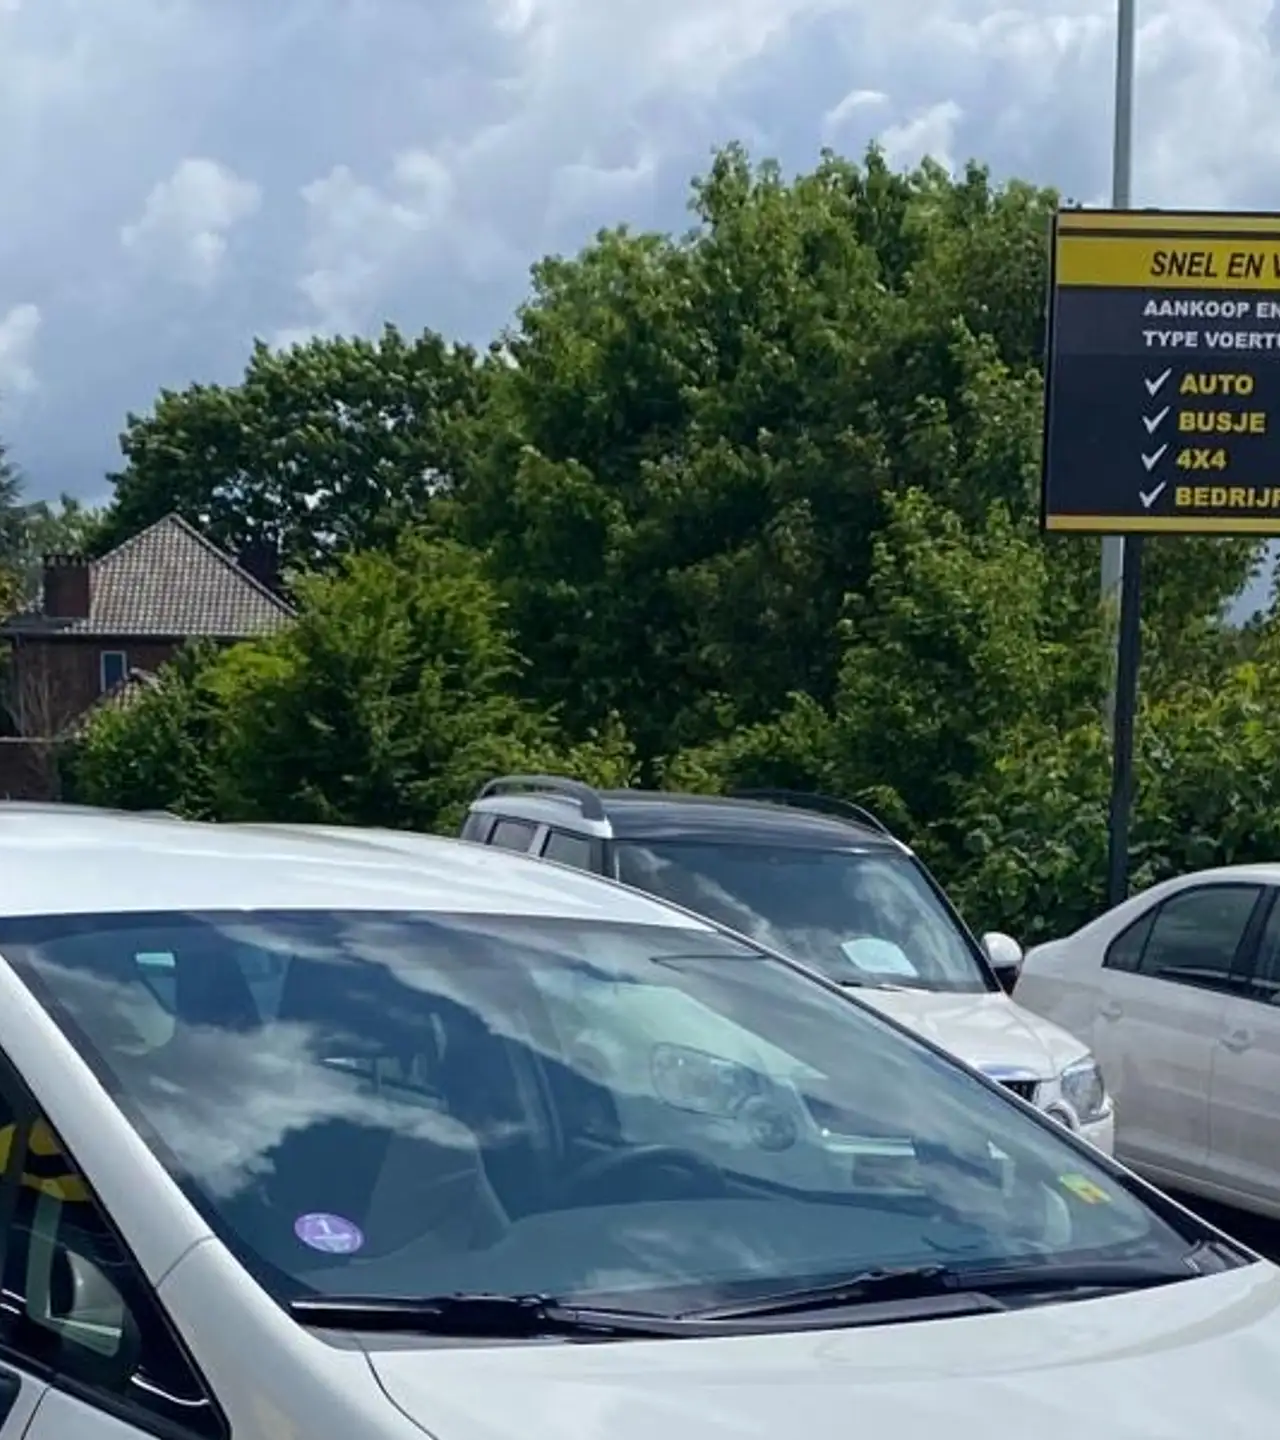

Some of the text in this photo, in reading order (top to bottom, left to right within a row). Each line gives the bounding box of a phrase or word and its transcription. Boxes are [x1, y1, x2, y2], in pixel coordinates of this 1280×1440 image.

[1150, 250, 1217, 277] SNEL
[1226, 252, 1265, 278] EN
[1143, 300, 1249, 318] AANKOOP
[1143, 331, 1198, 348] TYPE
[1179, 374, 1254, 395] AUTO
[1178, 412, 1266, 433] BUSJE
[1176, 449, 1227, 470] 4X4
